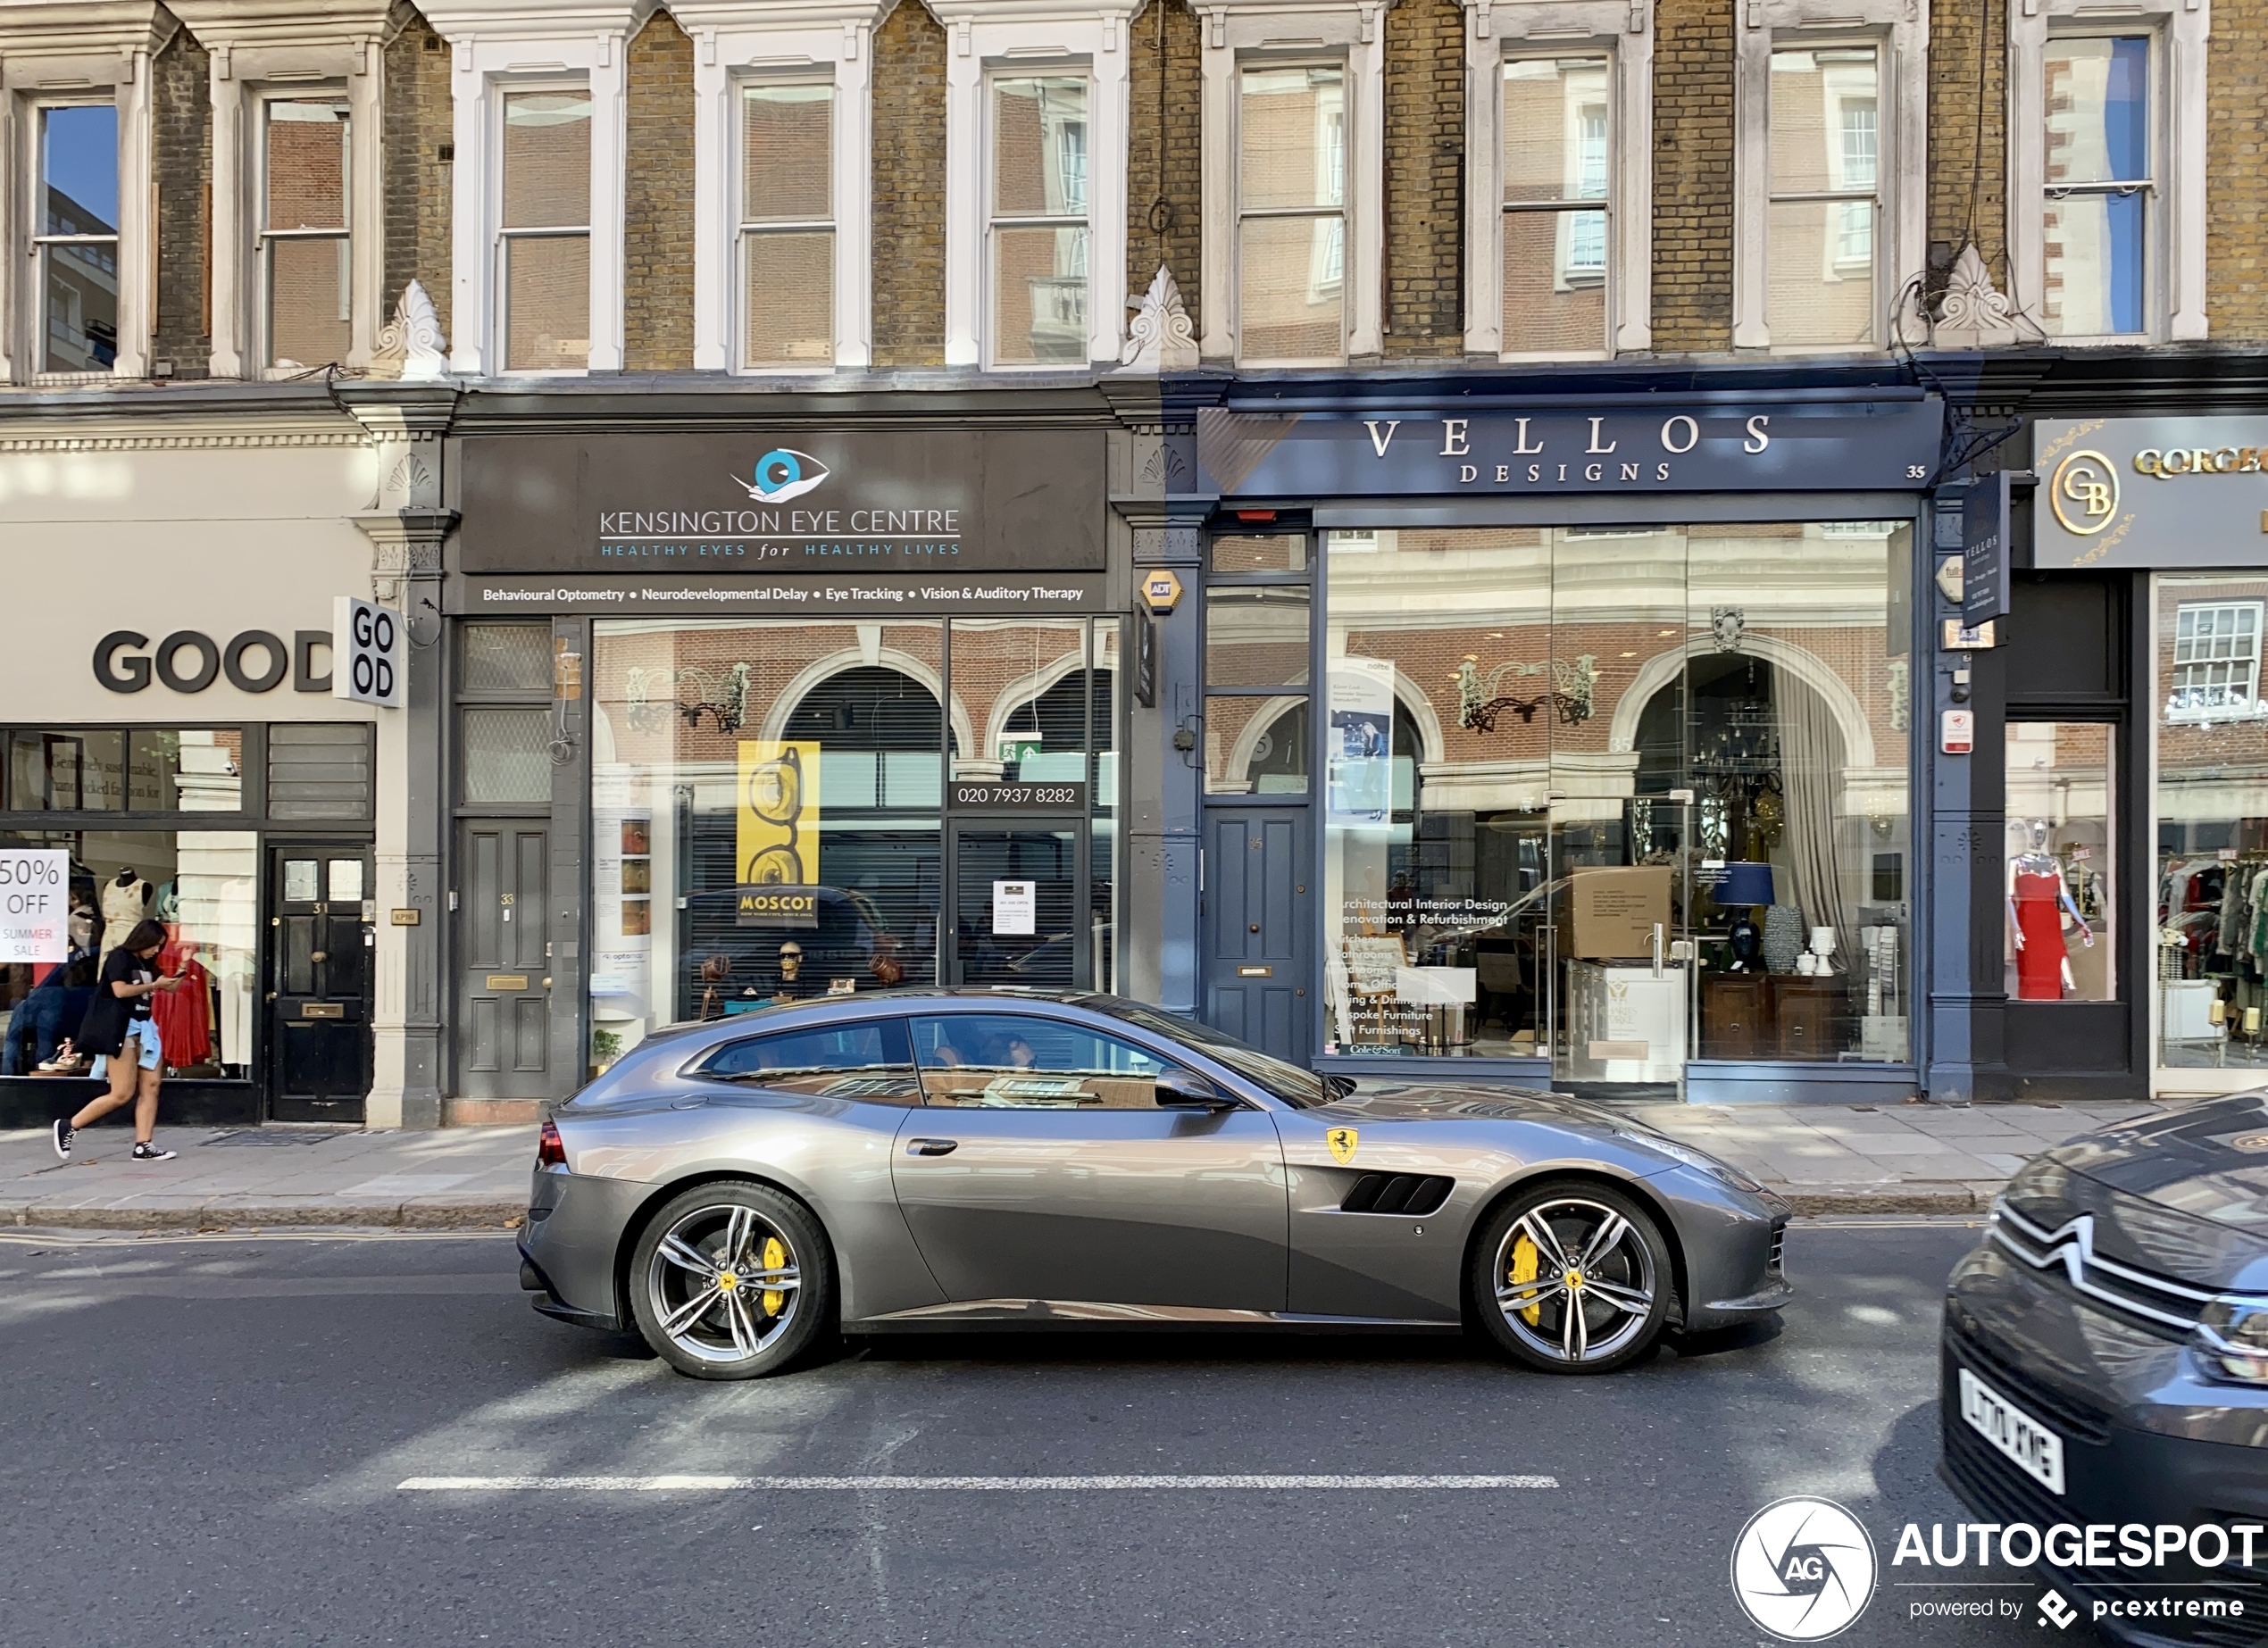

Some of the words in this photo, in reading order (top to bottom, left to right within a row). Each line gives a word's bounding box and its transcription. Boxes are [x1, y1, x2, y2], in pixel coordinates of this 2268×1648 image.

[1363, 415, 1770, 458] VELLOS
[1460, 462, 1670, 483] DESIGNS
[1905, 465, 1926, 479] 35
[600, 511, 780, 535] KENSINGTON
[791, 511, 839, 534] EYE
[851, 510, 960, 533] CENTRE
[602, 544, 688, 556] HEALTHY
[699, 544, 746, 555] EYES
[757, 543, 790, 560] for
[805, 543, 893, 555] HEALTHY
[905, 543, 959, 554] LIVES
[483, 588, 554, 601] Behavioural
[556, 588, 625, 603] Optometry
[642, 587, 771, 602] Neurodevelopmental
[772, 587, 808, 602] Delay
[825, 587, 848, 602] Eye
[850, 587, 904, 602] Tracking
[921, 587, 959, 600] Vision
[962, 587, 972, 599] &
[974, 587, 1029, 602] Auditory
[1031, 586, 1083, 602] Therapy
[1151, 584, 1172, 594] ADT
[353, 606, 394, 655] GO
[92, 629, 335, 694] GOOD
[353, 656, 394, 699] OD
[1610, 737, 1632, 753] 35
[957, 788, 988, 803] 020
[992, 788, 1032, 803] 7937
[1035, 788, 1075, 803] 8282
[0, 859, 59, 886] 50%
[7, 894, 49, 914] OFF
[500, 894, 514, 905] 33
[739, 895, 814, 911] MOSCOT
[1416, 898, 1462, 910] Interior
[1464, 898, 1508, 912] Design
[313, 903, 329, 914] 31
[1342, 914, 1403, 925] enovation
[1406, 914, 1415, 925] &
[1419, 914, 1508, 925] Refurbishment
[3, 928, 53, 939] SUMMER
[13, 945, 41, 956] SALE
[1369, 995, 1378, 1004] &
[1383, 1010, 1434, 1020] Furniture
[1359, 1025, 1422, 1038] Furnishings
[1349, 1045, 1372, 1054] Cole
